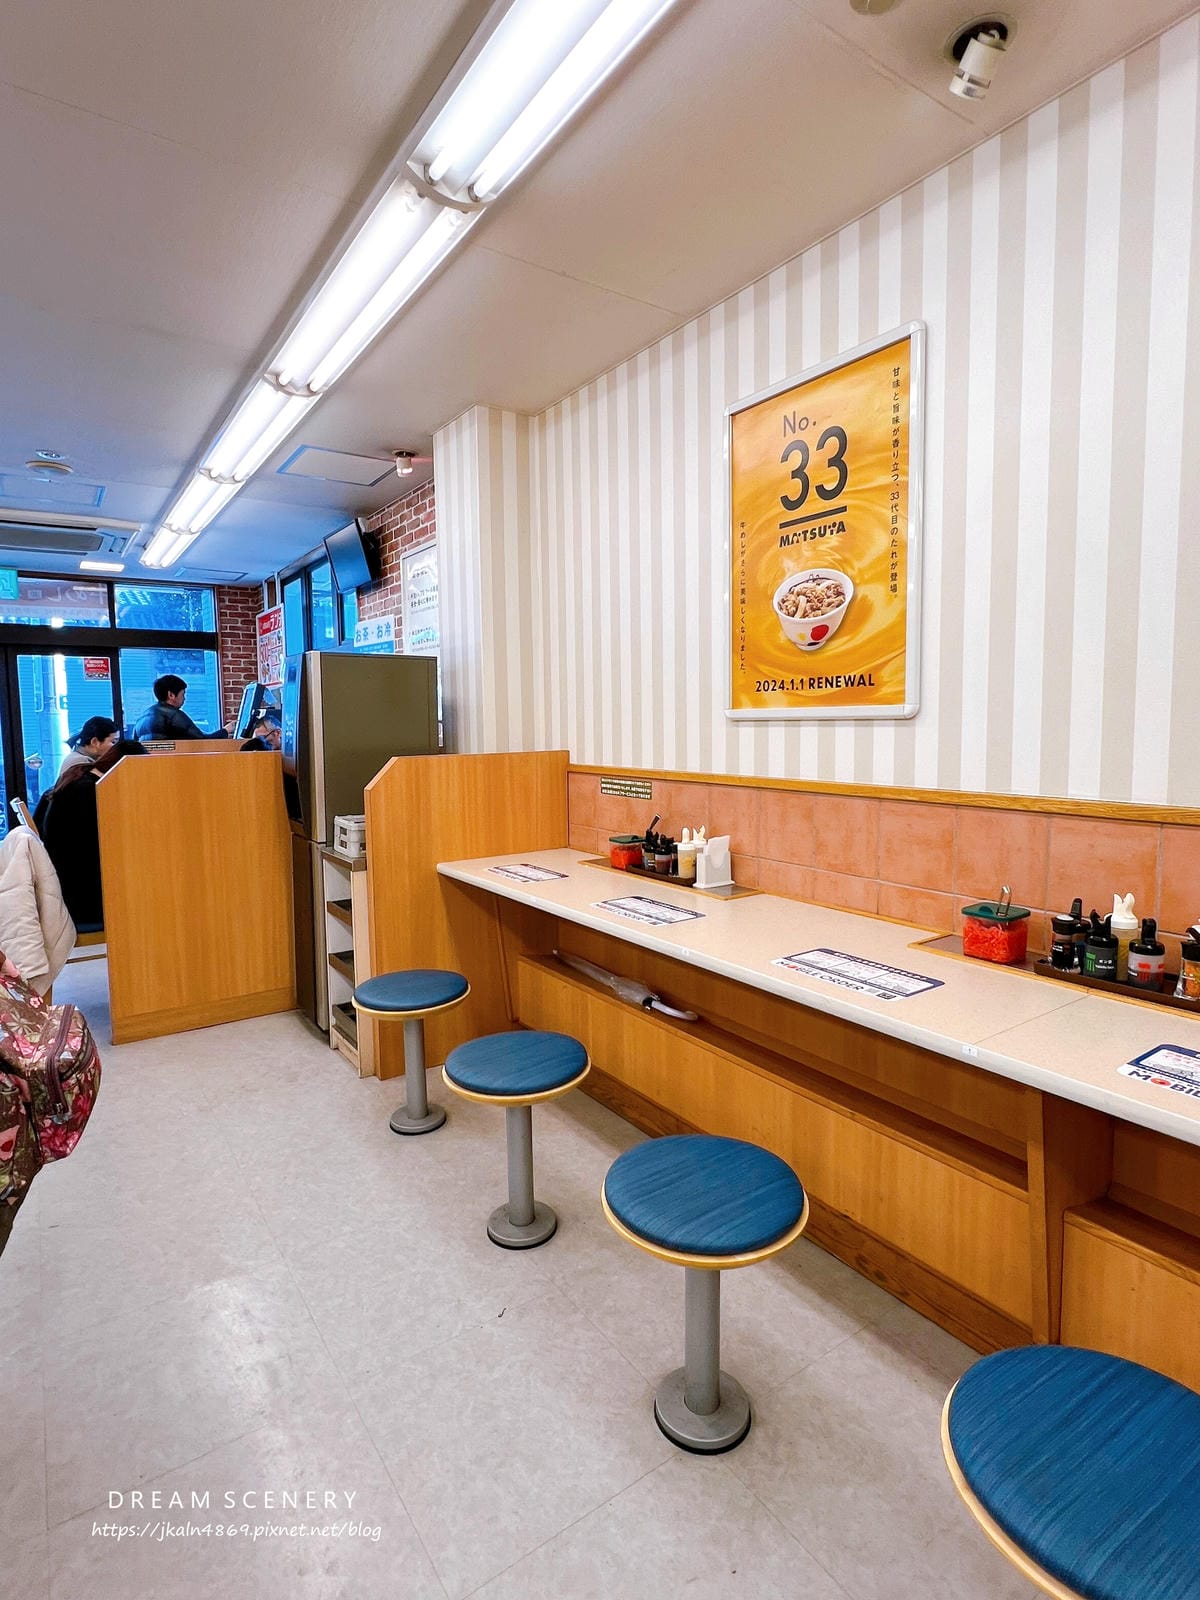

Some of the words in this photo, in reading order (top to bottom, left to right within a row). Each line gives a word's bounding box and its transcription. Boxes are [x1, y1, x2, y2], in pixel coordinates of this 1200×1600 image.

[783, 410, 817, 438] No.
[779, 425, 848, 511] 33
[779, 520, 846, 547] MATSUYA
[755, 678, 805, 693] 2024.1.1
[808, 673, 876, 690] RENEWAL
